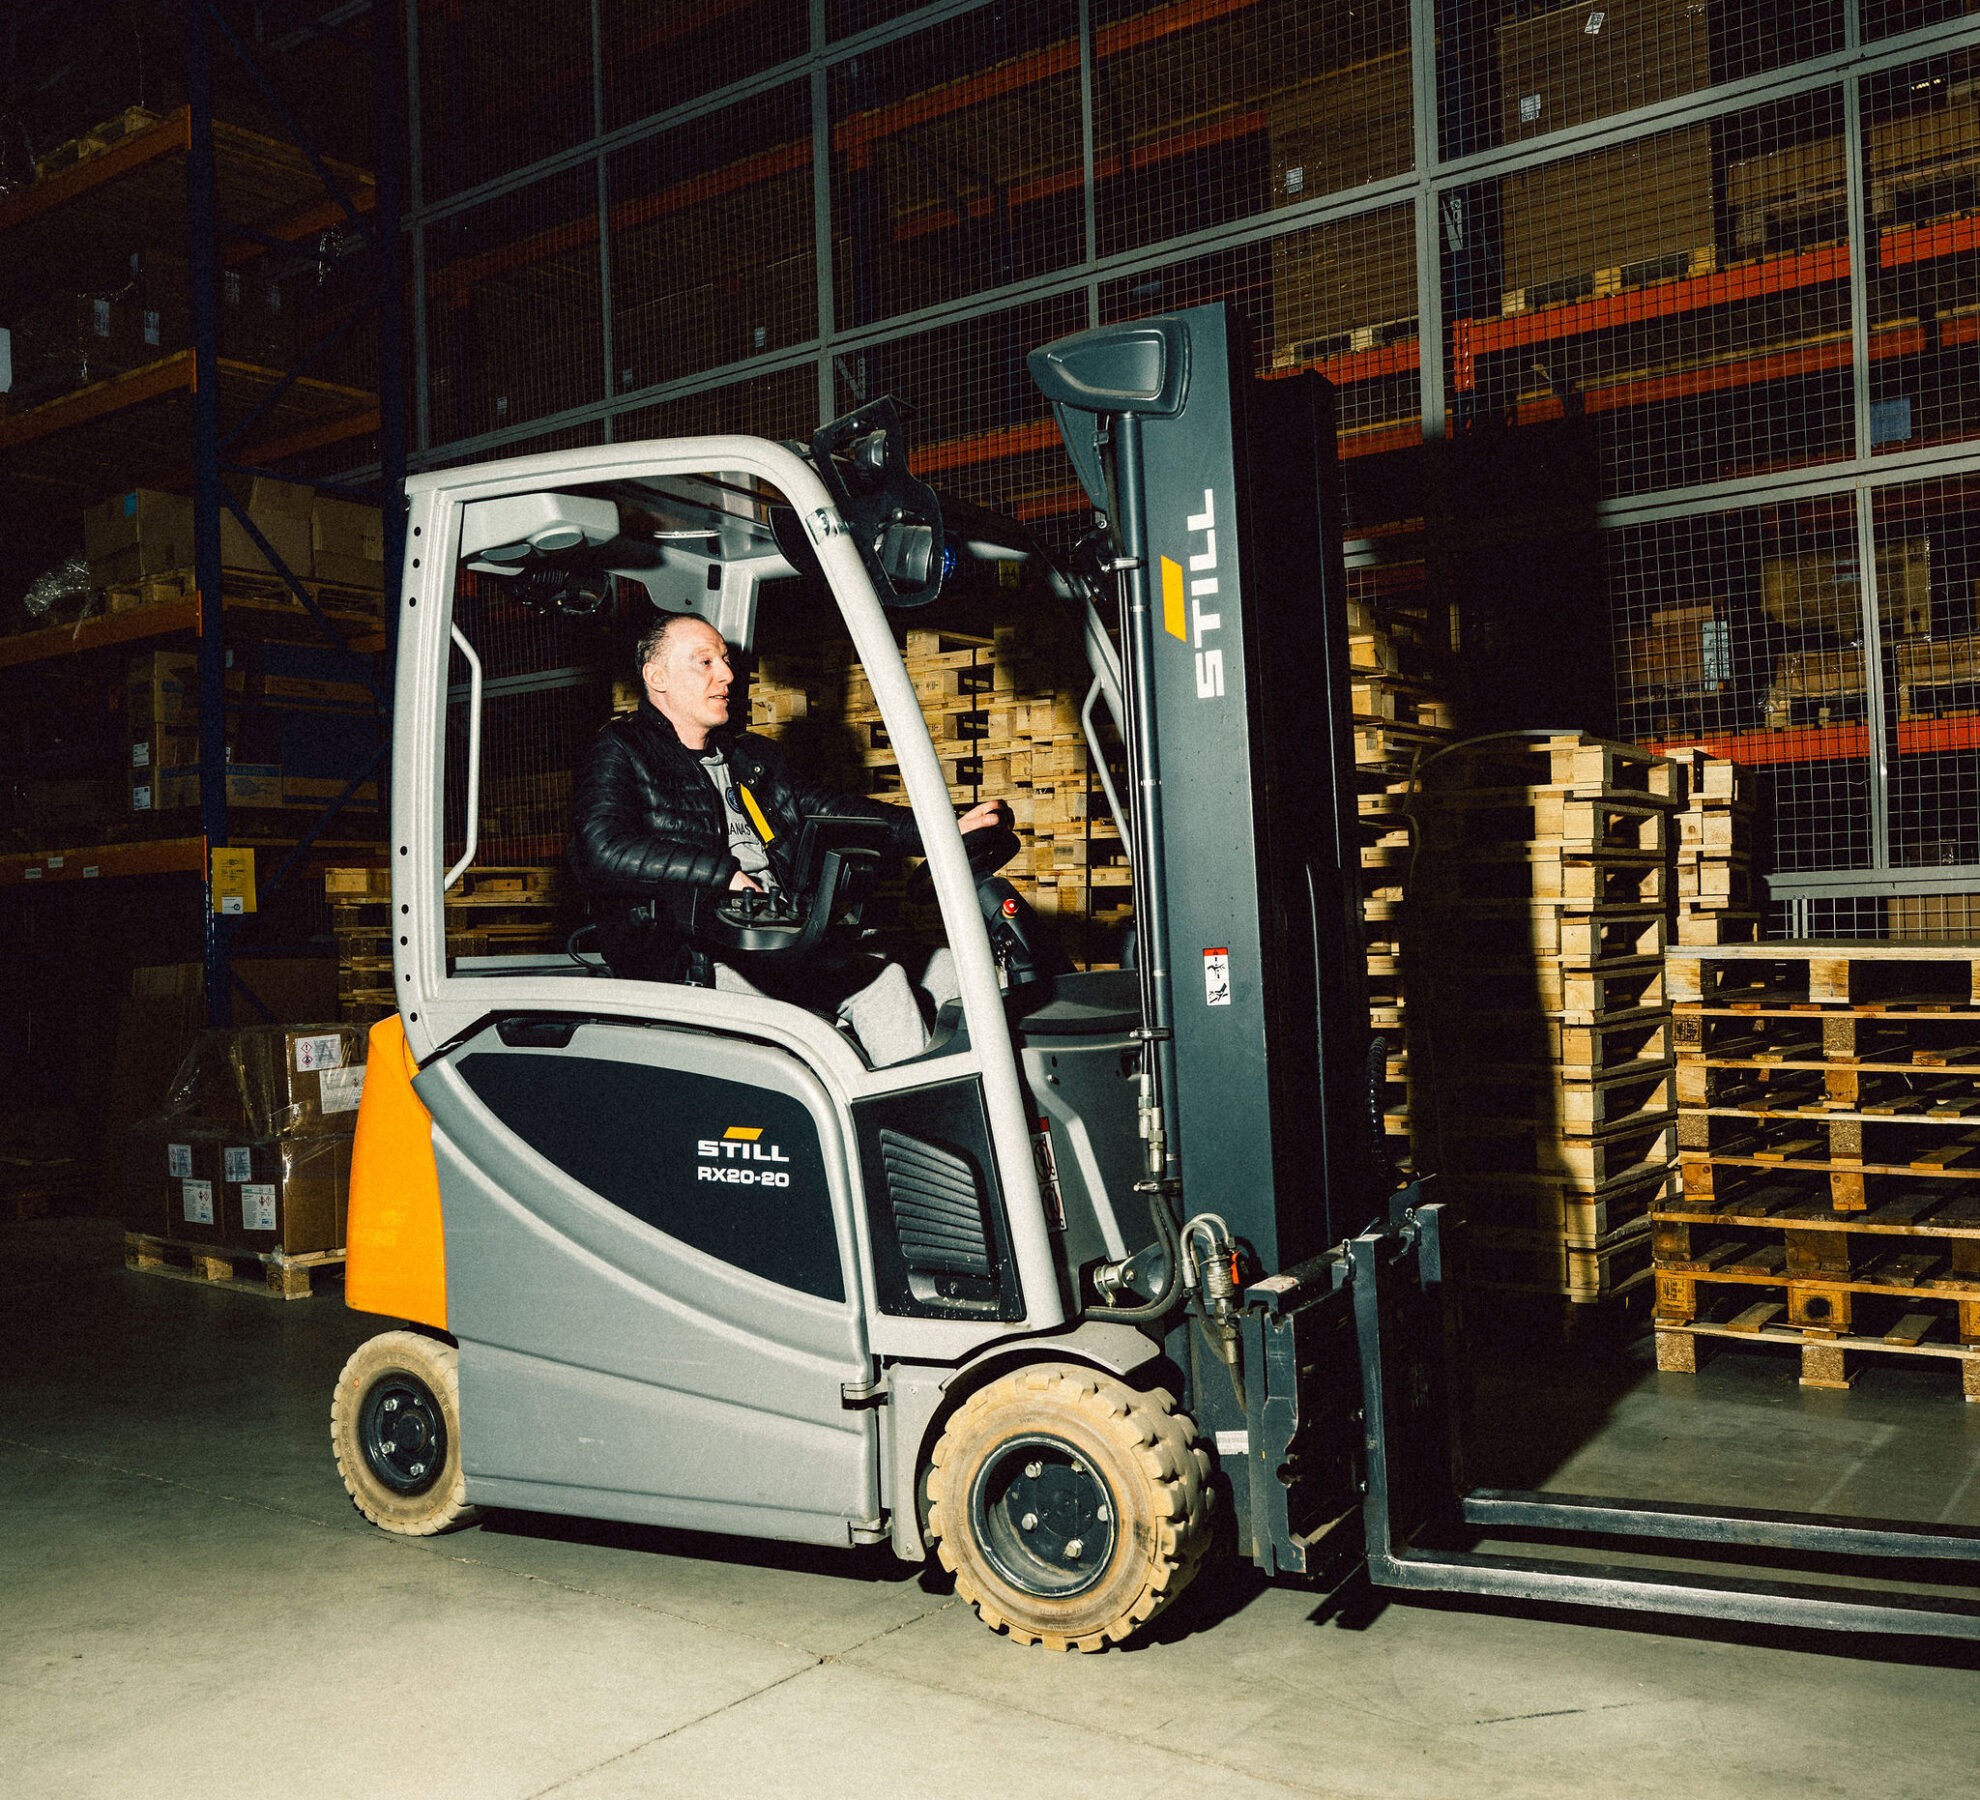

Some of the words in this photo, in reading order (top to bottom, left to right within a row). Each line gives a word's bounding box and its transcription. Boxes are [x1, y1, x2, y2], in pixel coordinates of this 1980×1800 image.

[1187, 488, 1225, 699] STILL
[697, 1139, 790, 1163] STILL
[697, 1165, 790, 1188] RX20-20
